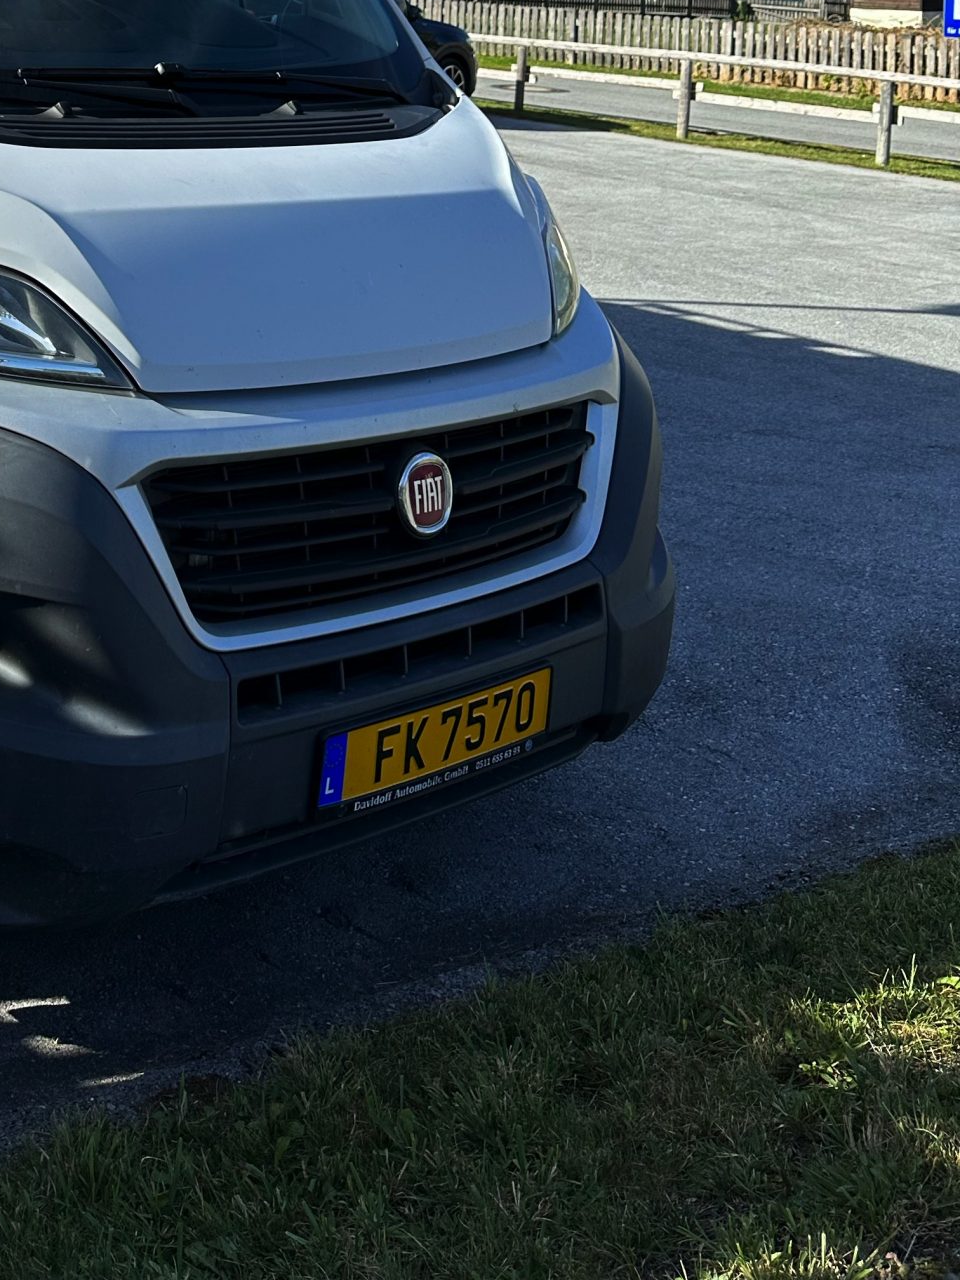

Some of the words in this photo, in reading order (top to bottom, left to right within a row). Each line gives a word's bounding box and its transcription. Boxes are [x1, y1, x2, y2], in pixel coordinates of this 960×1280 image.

[413, 475, 443, 515] FIAT
[373, 714, 430, 784] FK
[440, 679, 536, 762] 7570
[325, 776, 334, 795] L
[353, 790, 393, 812] Davidoff
[393, 775, 442, 800] Automobile
[444, 765, 469, 781] GmbH
